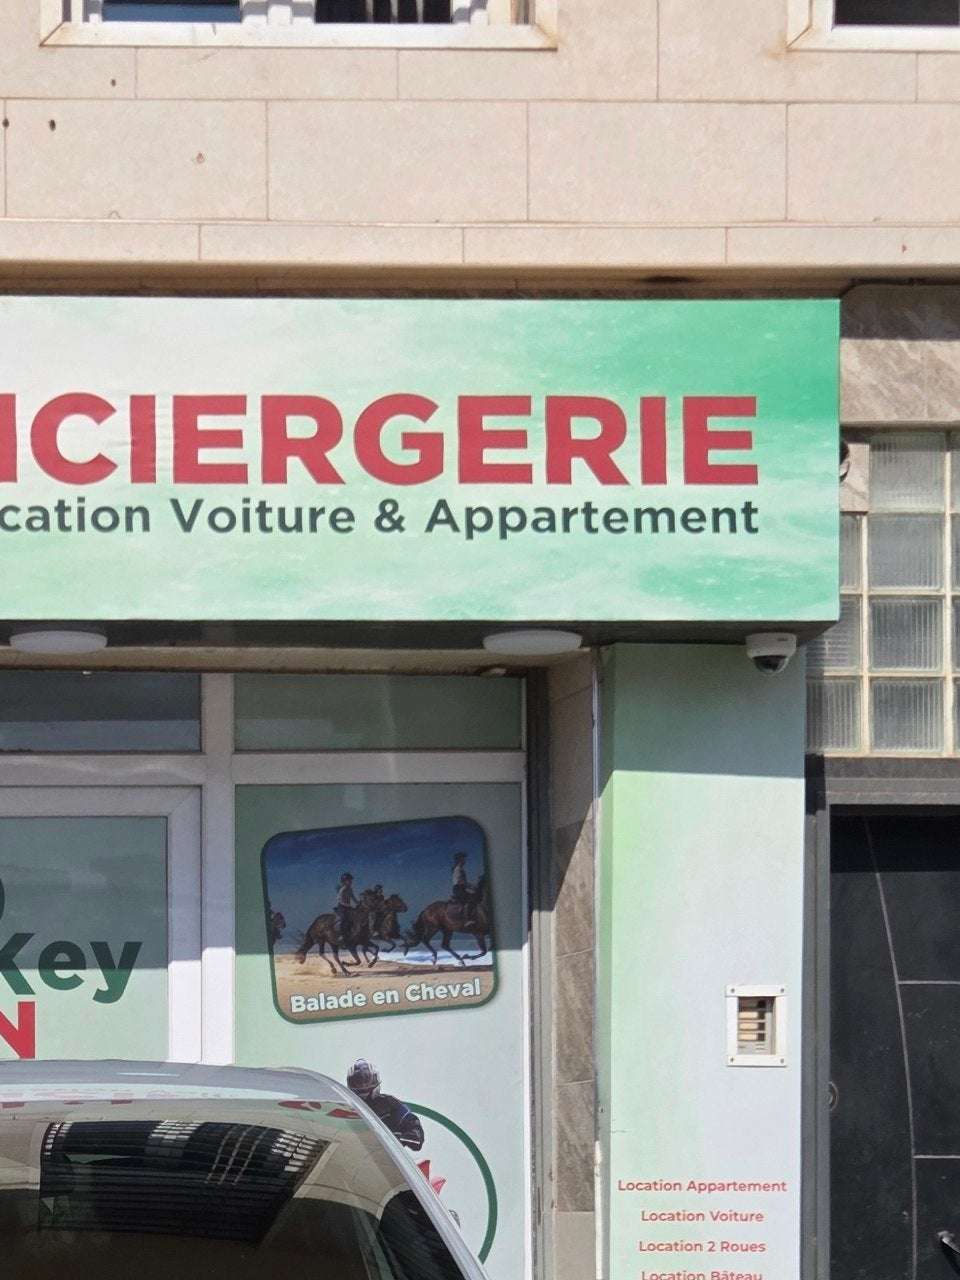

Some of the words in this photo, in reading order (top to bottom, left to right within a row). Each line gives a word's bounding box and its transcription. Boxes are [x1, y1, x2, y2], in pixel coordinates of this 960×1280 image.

[169, 497, 355, 533] Voiture
[374, 498, 407, 533] &
[424, 498, 759, 540] Appartement
[290, 988, 368, 1014] Balade
[372, 986, 400, 1005] en
[405, 976, 481, 1002] Cheval
[617, 1179, 682, 1192] Location
[686, 1180, 788, 1194] Appartement
[641, 1209, 705, 1222] Location
[709, 1210, 765, 1222] Voiture
[639, 1240, 703, 1252] Location
[707, 1240, 716, 1252] 2
[720, 1240, 767, 1253] Roues
